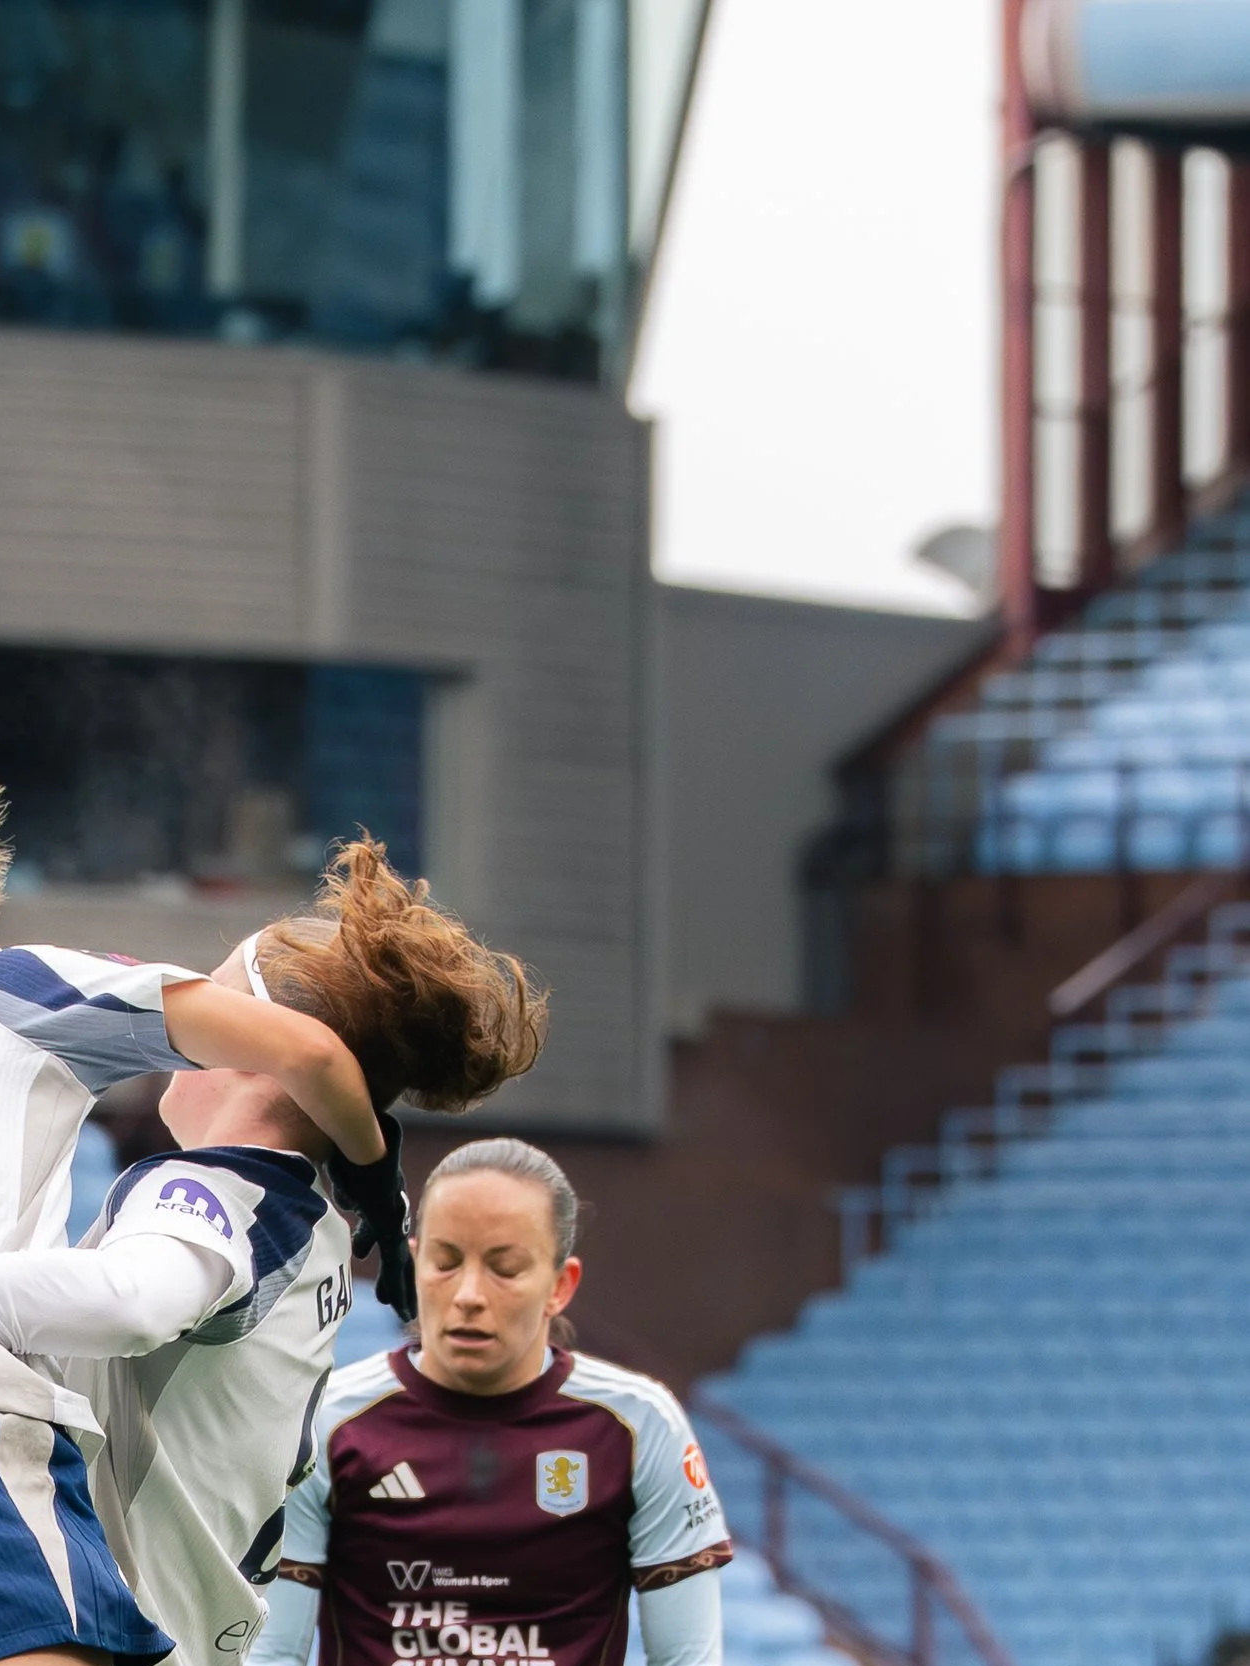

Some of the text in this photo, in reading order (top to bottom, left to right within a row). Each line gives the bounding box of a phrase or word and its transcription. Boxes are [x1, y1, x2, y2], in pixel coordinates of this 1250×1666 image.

[433, 1577, 470, 1586] Women
[480, 1575, 509, 1588] Sport
[387, 1601, 470, 1627] THE
[391, 1624, 550, 1658] GLOBAL
